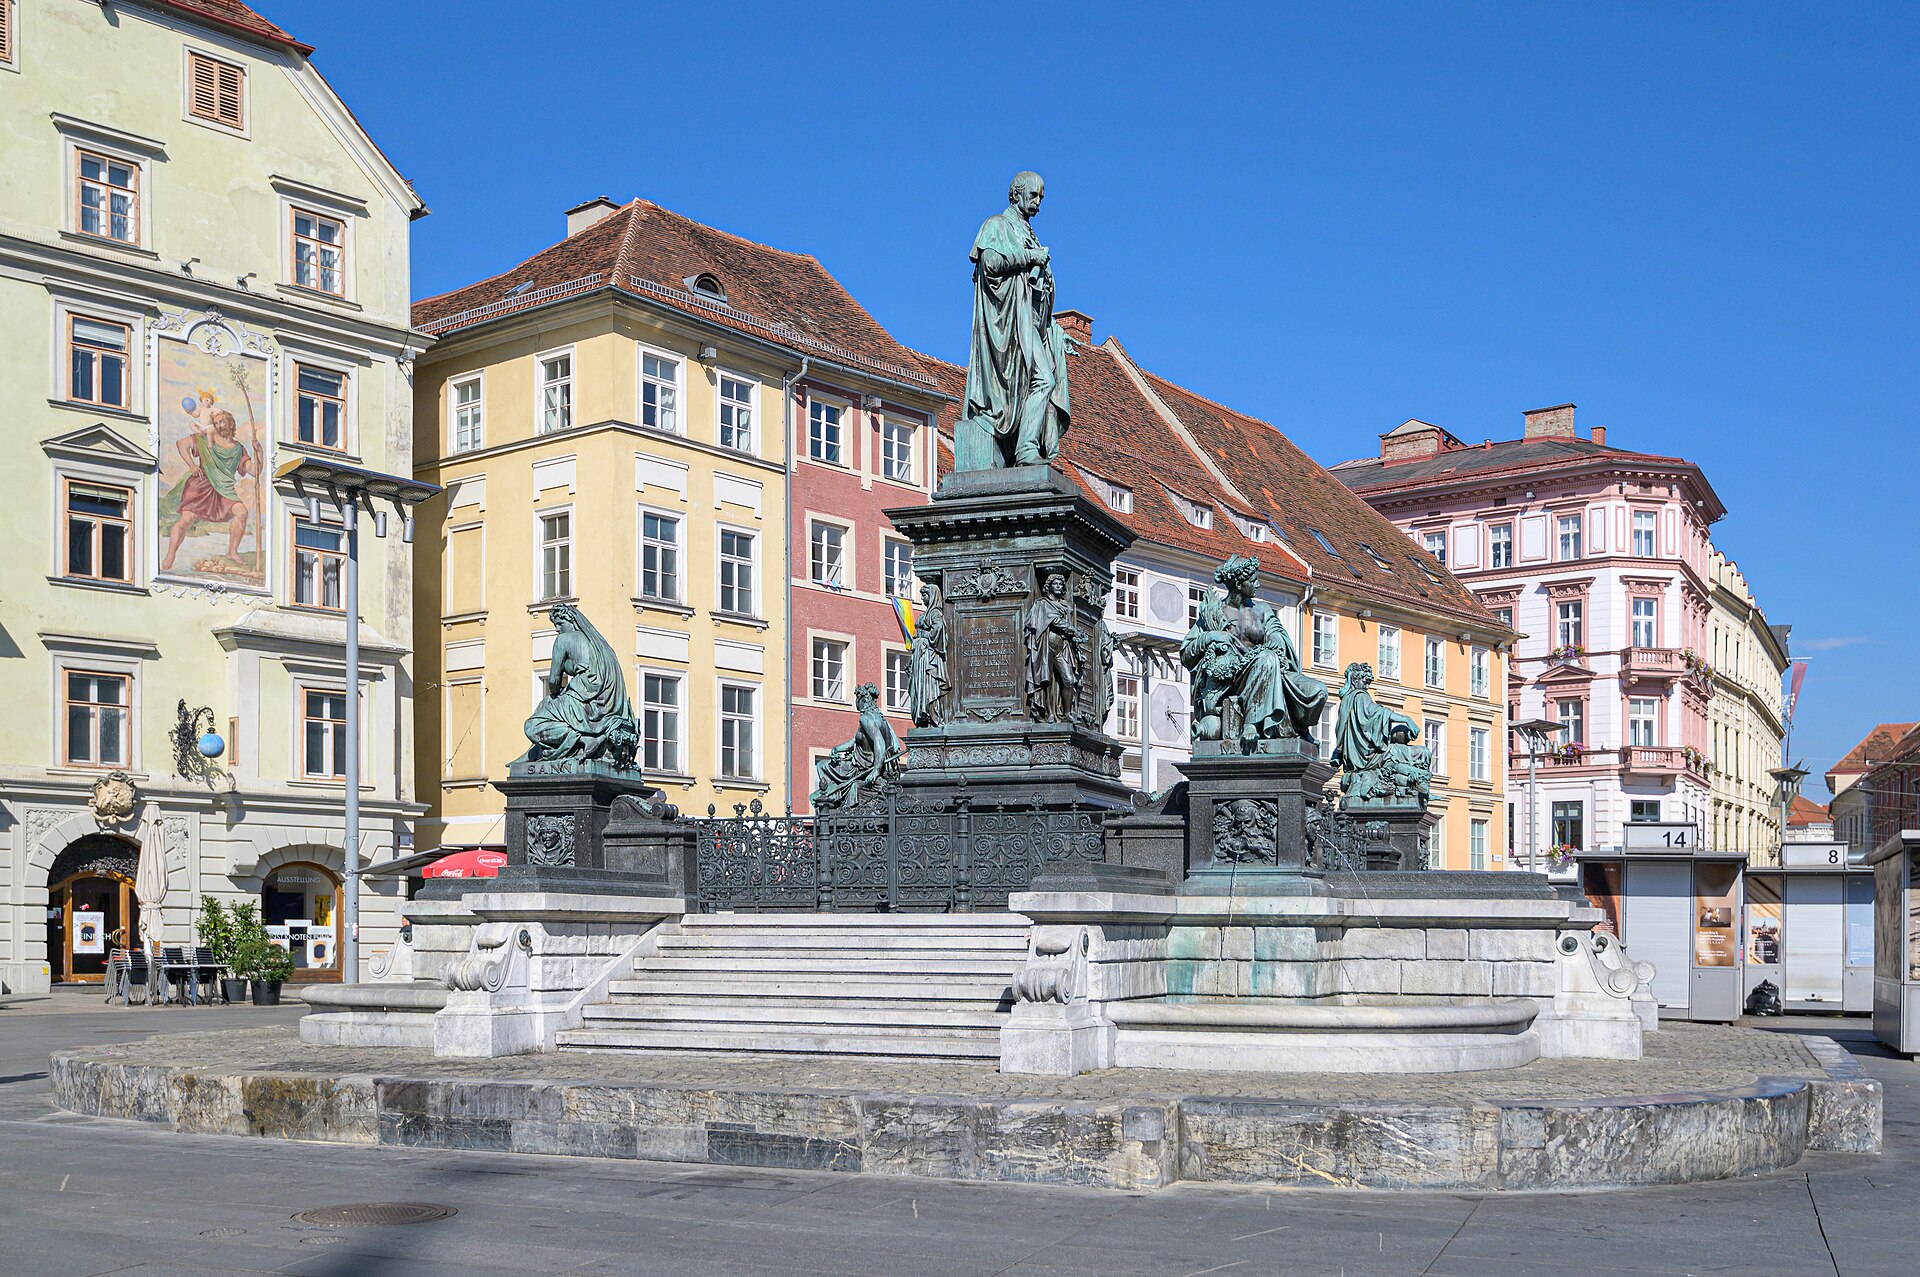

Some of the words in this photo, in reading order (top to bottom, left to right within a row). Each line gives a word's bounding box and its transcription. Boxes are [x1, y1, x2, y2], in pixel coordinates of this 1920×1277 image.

[1220, 742, 1268, 755] MR
[527, 763, 573, 774] SANN
[1663, 832, 1686, 847] 14
[1829, 850, 1838, 863] 8
